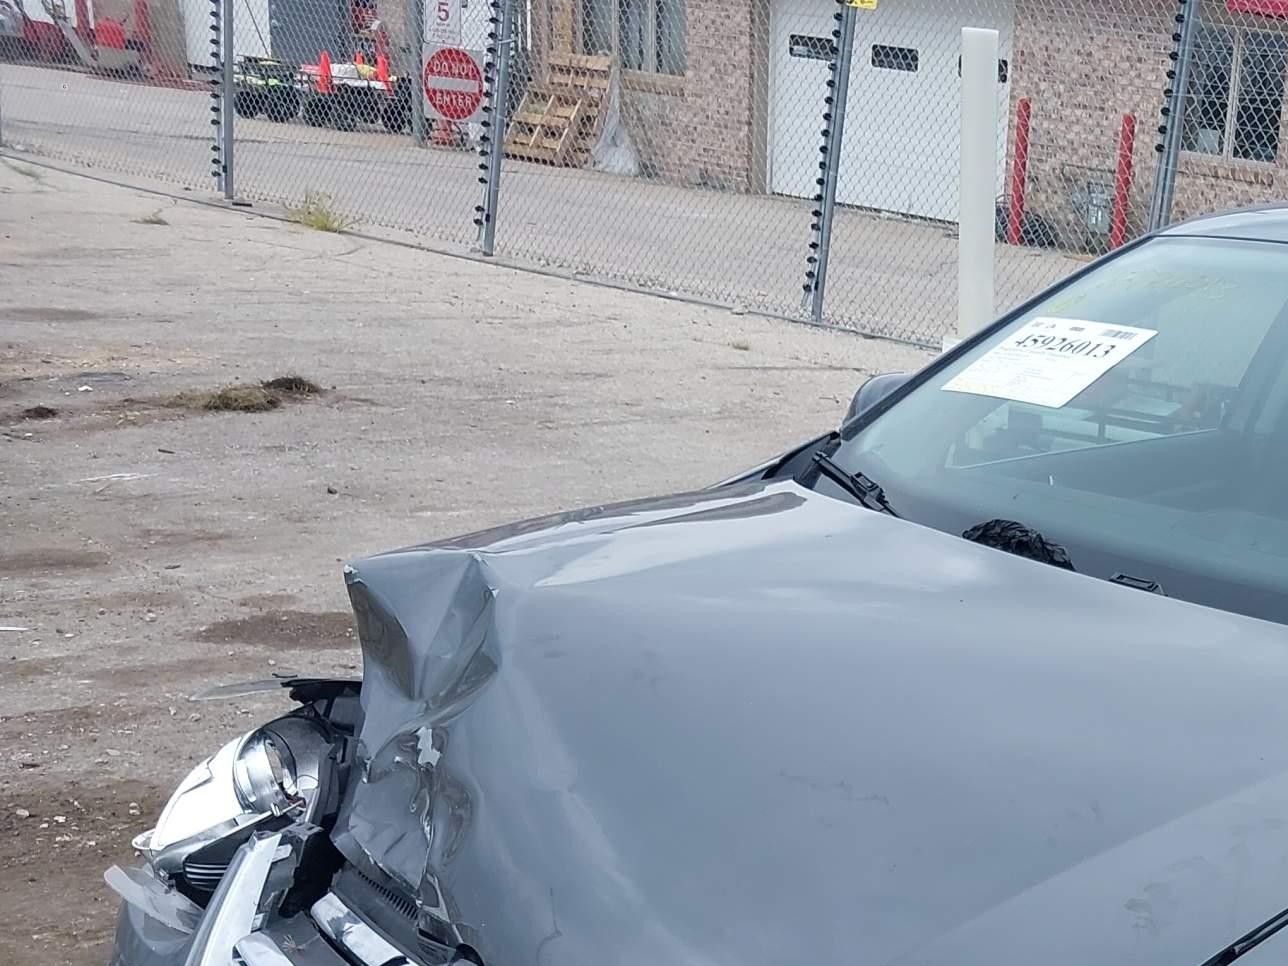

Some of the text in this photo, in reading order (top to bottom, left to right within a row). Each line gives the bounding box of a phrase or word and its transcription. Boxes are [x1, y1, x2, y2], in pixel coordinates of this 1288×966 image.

[437, 2, 449, 21] 5
[433, 61, 474, 76] DO NOT
[435, 91, 472, 106] ENTER
[1015, 334, 1116, 358] 45926013
